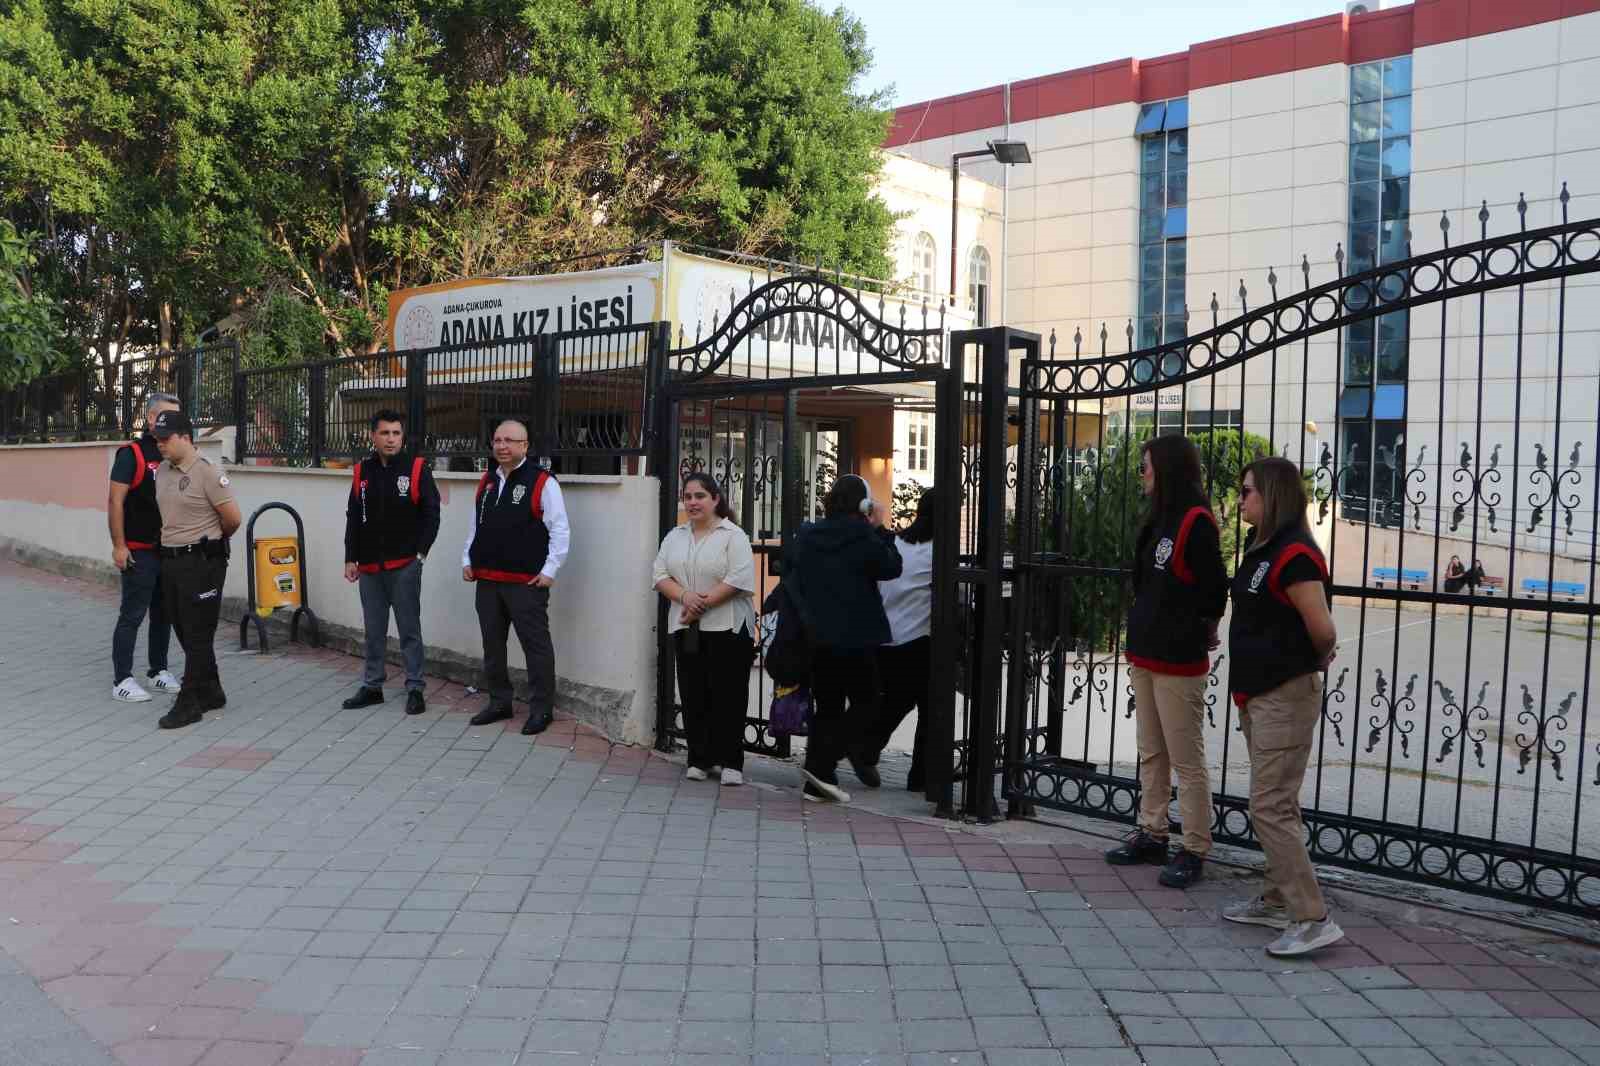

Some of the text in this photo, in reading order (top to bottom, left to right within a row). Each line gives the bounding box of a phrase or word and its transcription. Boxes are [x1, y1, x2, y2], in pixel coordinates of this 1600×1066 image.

[443, 298, 503, 315] ADANA-ÇUKUROVA
[440, 314, 505, 349] ADANA
[513, 308, 550, 339] KIZ
